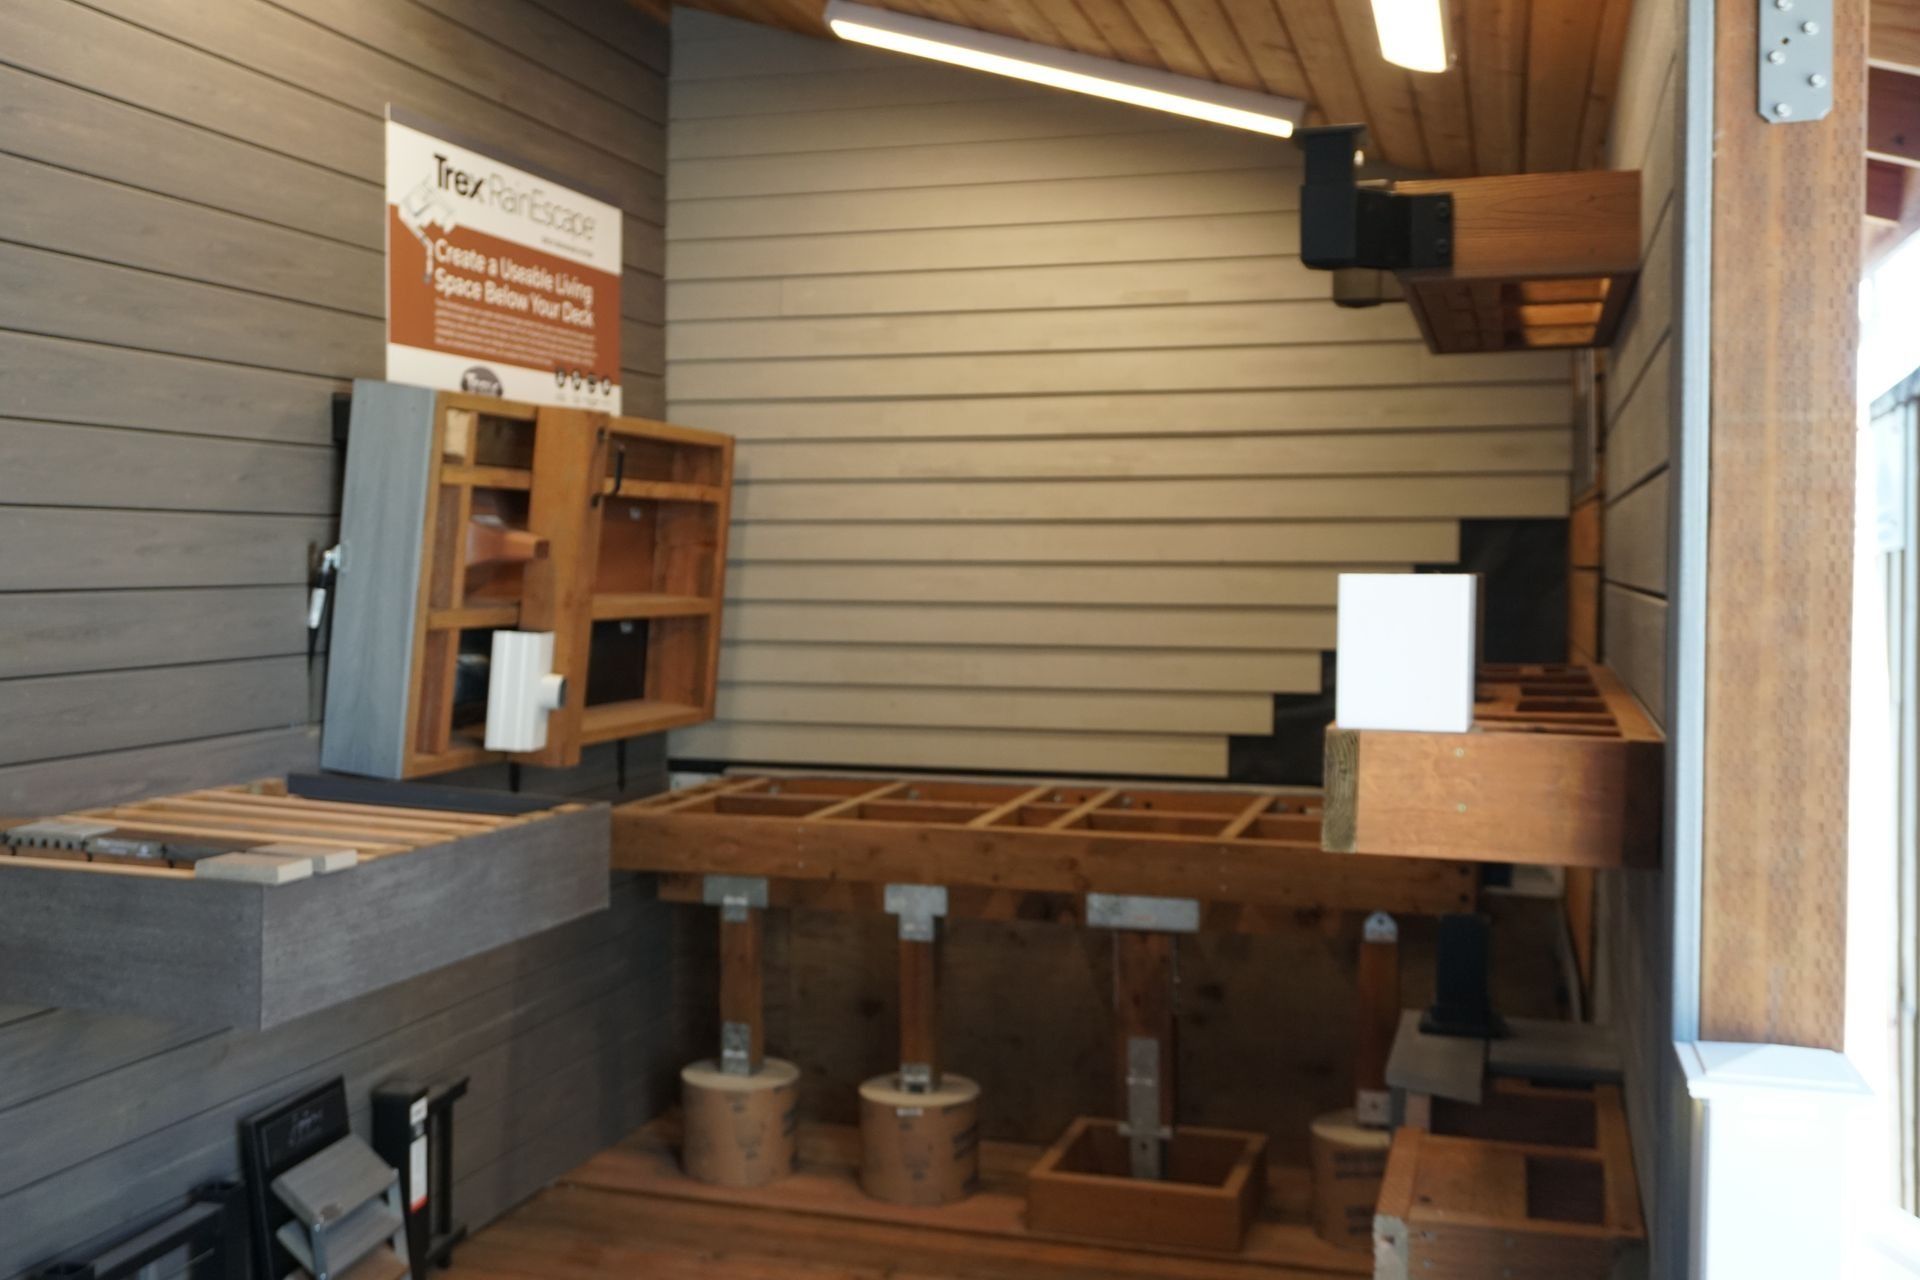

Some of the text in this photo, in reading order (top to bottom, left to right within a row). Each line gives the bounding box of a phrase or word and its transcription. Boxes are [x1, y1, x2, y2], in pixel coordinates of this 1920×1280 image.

[434, 153, 486, 202] Trex
[434, 268, 594, 328] Space Below Your Deck
[435, 239, 594, 308] Create a Useable Living
